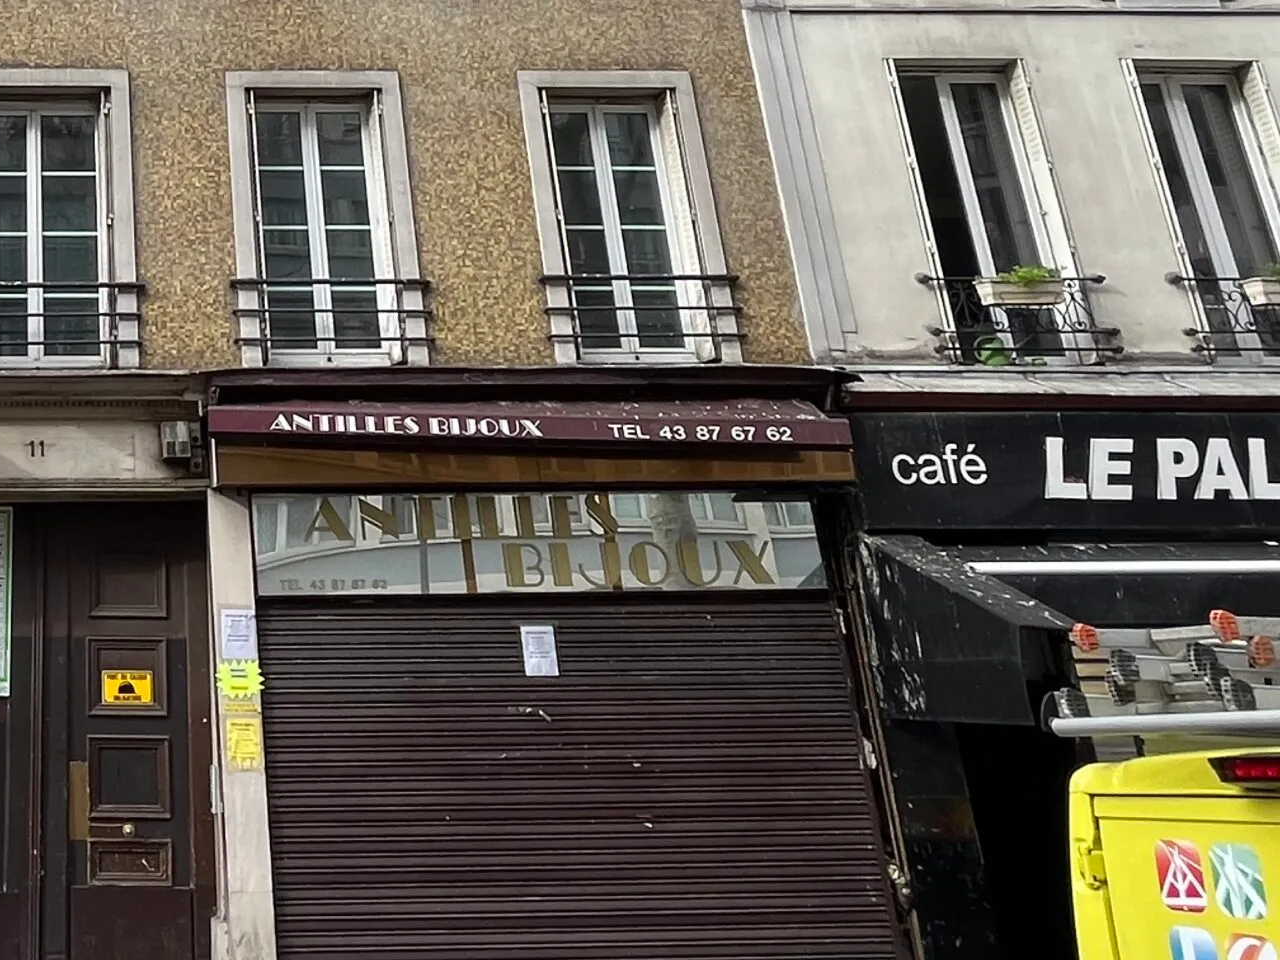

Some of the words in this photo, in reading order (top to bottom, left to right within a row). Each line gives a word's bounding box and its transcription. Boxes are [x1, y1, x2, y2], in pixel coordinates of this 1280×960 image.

[269, 413, 420, 434] ANTILLES
[429, 417, 544, 437] BIJOUX
[608, 424, 650, 439] TEL
[659, 425, 687, 439] 43
[696, 426, 720, 440] 87
[731, 426, 756, 441] 67
[766, 426, 794, 441] 62
[29, 440, 45, 457] 11
[891, 444, 988, 485] café
[1044, 437, 1134, 500] LE
[1156, 437, 1280, 500] PAL
[303, 494, 618, 542] ANTILLES
[502, 540, 777, 588] BIJOUX
[280, 579, 304, 590] TEL
[310, 579, 326, 590] 43
